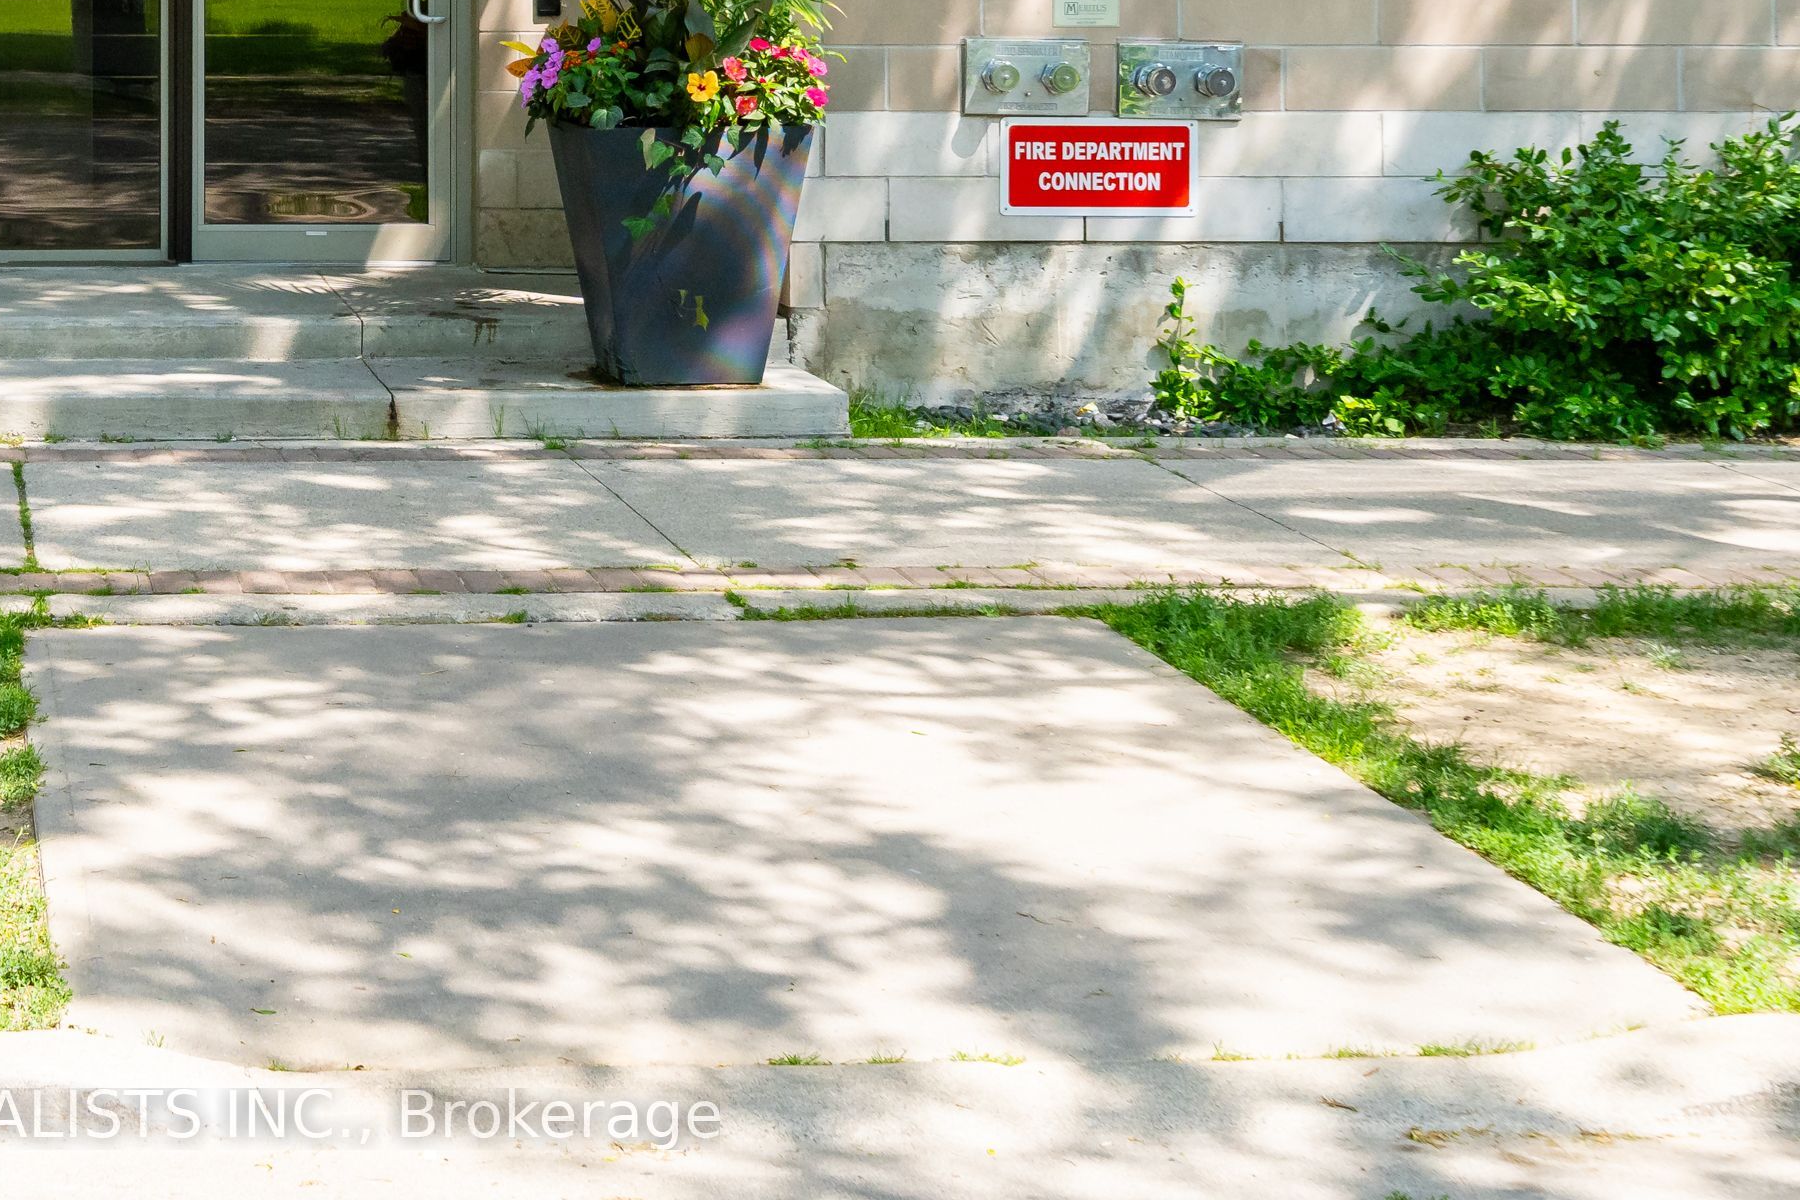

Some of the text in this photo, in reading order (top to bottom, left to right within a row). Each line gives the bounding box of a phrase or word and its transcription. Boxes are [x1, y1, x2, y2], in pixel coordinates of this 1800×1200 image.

[1015, 141, 1185, 161] FIRE DEPARTMENT
[1038, 171, 1161, 191] CONNECTION
